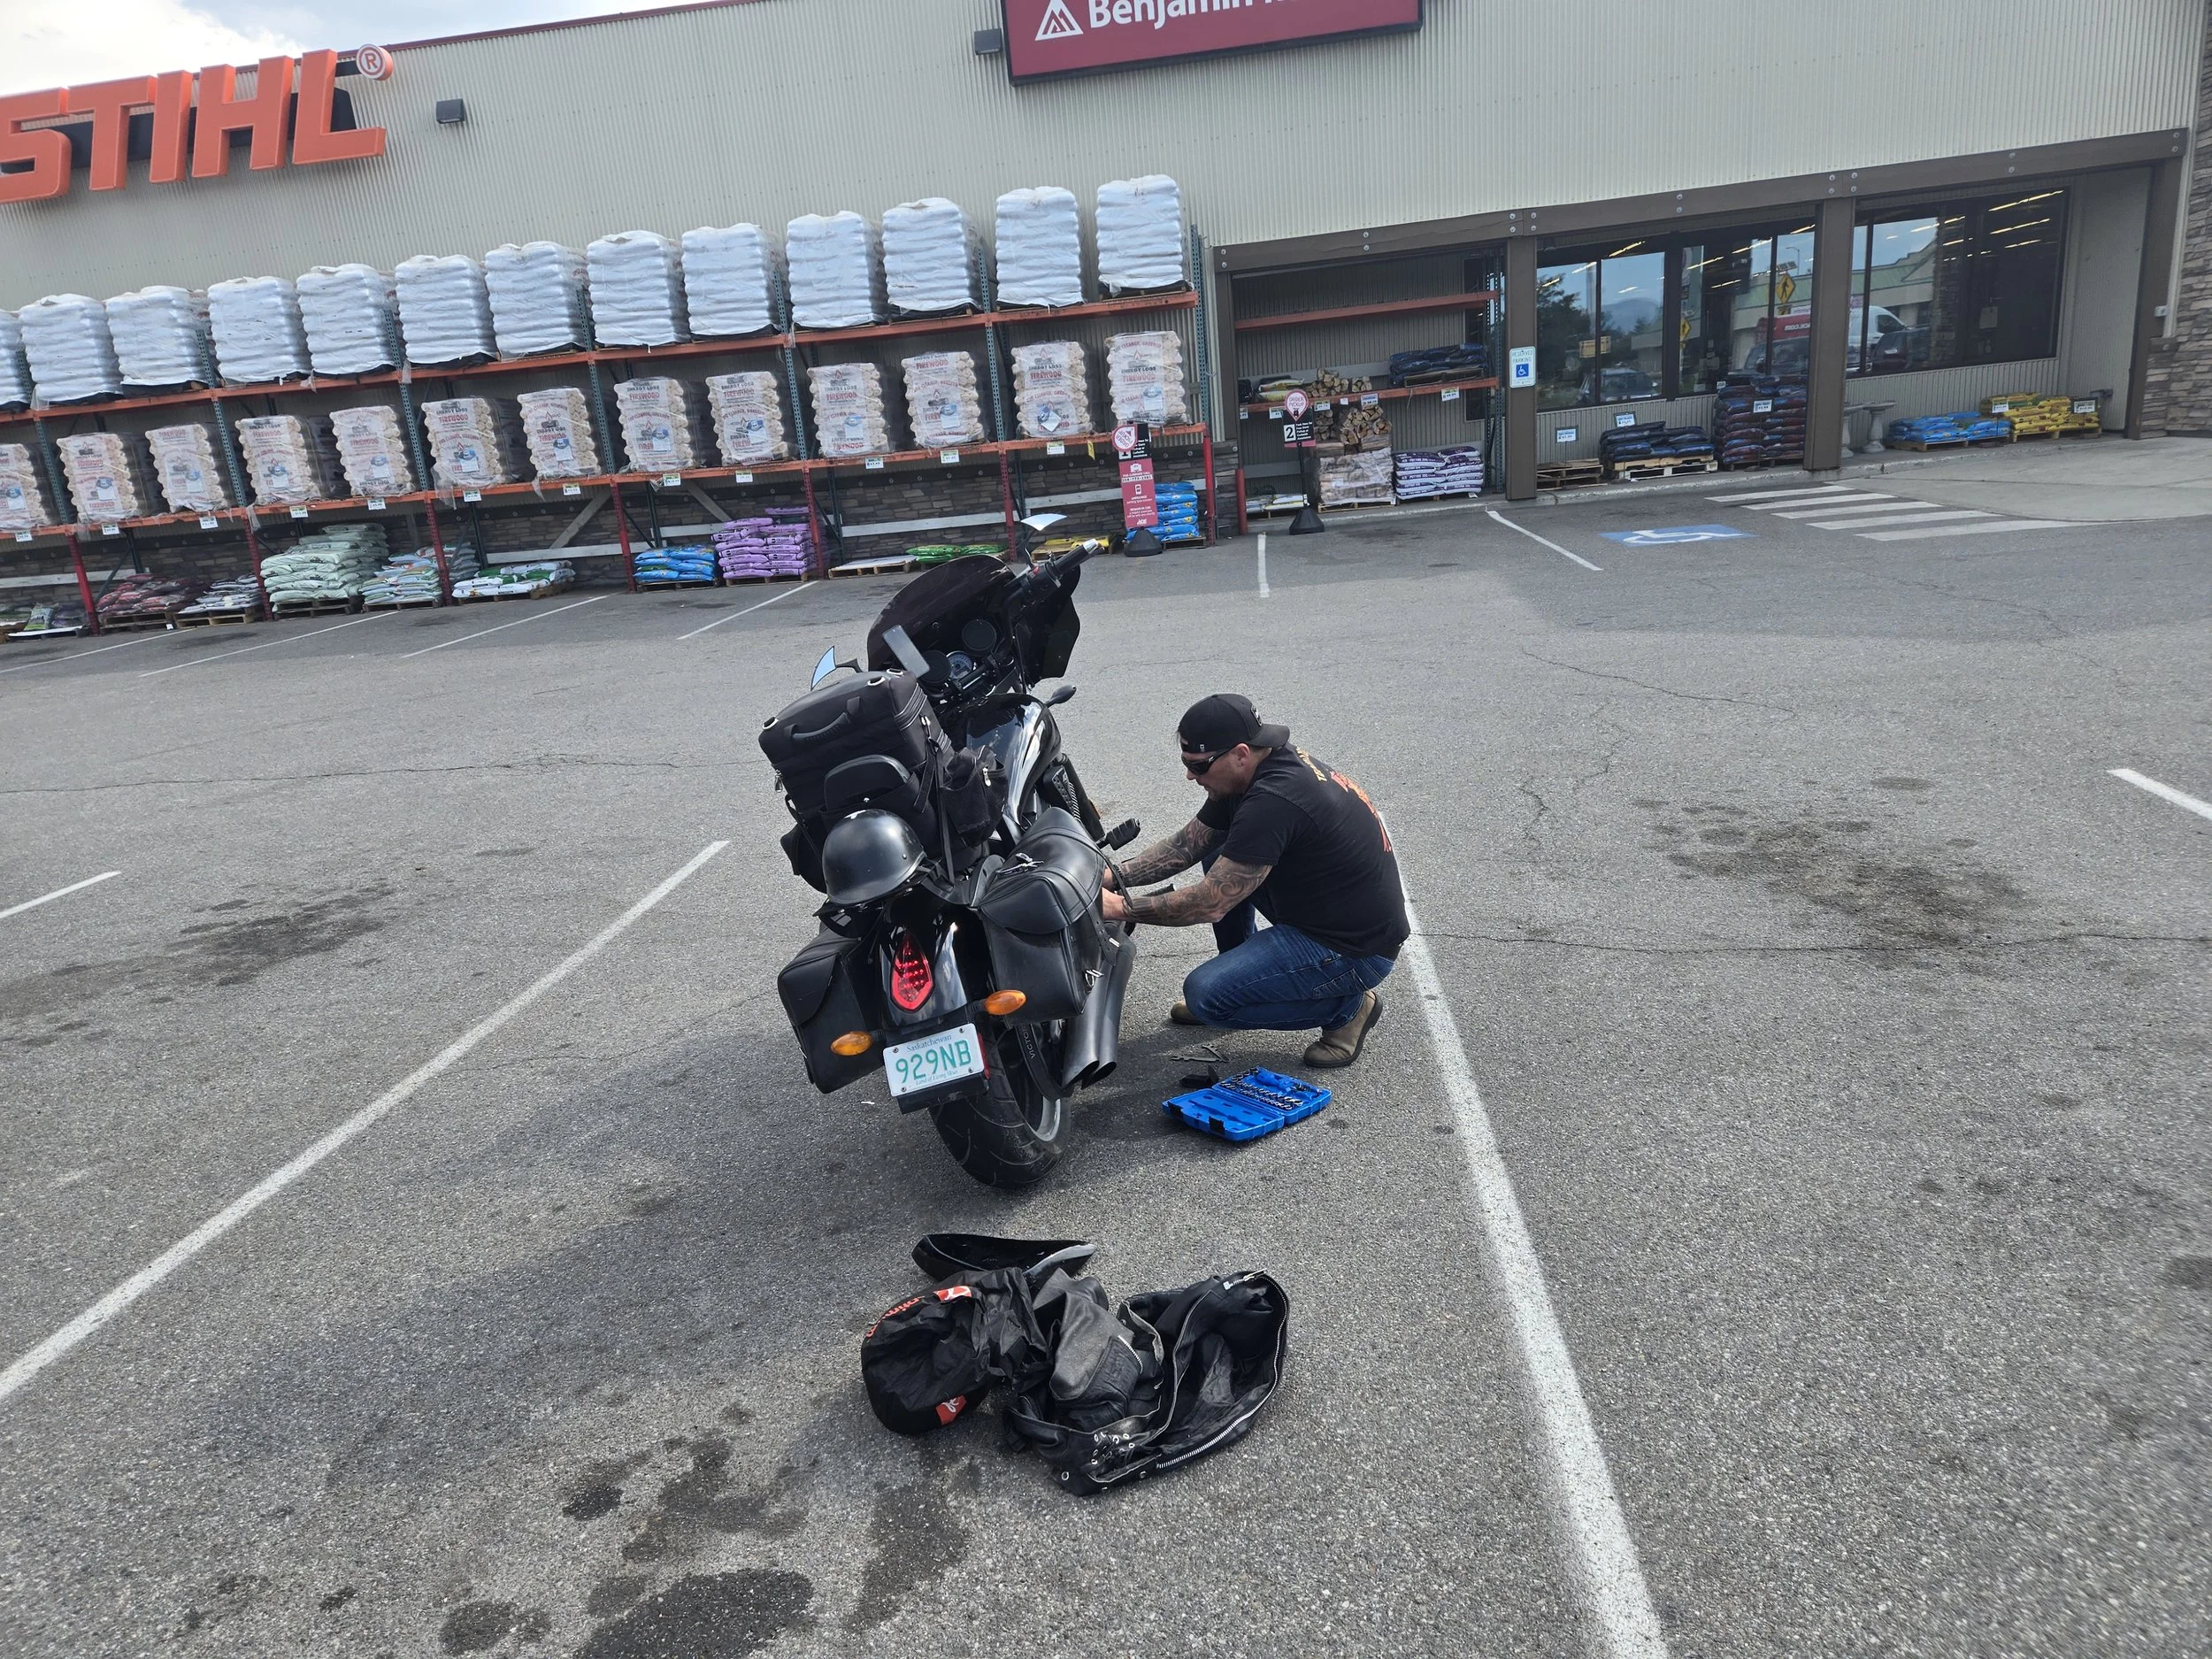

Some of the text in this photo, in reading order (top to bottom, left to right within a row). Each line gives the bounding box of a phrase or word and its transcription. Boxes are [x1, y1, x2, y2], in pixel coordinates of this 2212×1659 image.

[0, 49, 387, 204] STIHL
[916, 359, 948, 369] FIREWOOD
[1031, 371, 1061, 379] FIREWOOD
[1123, 373, 1155, 382] FIREWOOD
[630, 392, 659, 401] FIREWOOD
[826, 392, 857, 400] FIREWOOD
[439, 414, 468, 423] FIREWOOD
[1286, 427, 1294, 439] 2
[906, 1034, 952, 1052] Saskatchewan
[896, 1040, 971, 1084] 929NB
